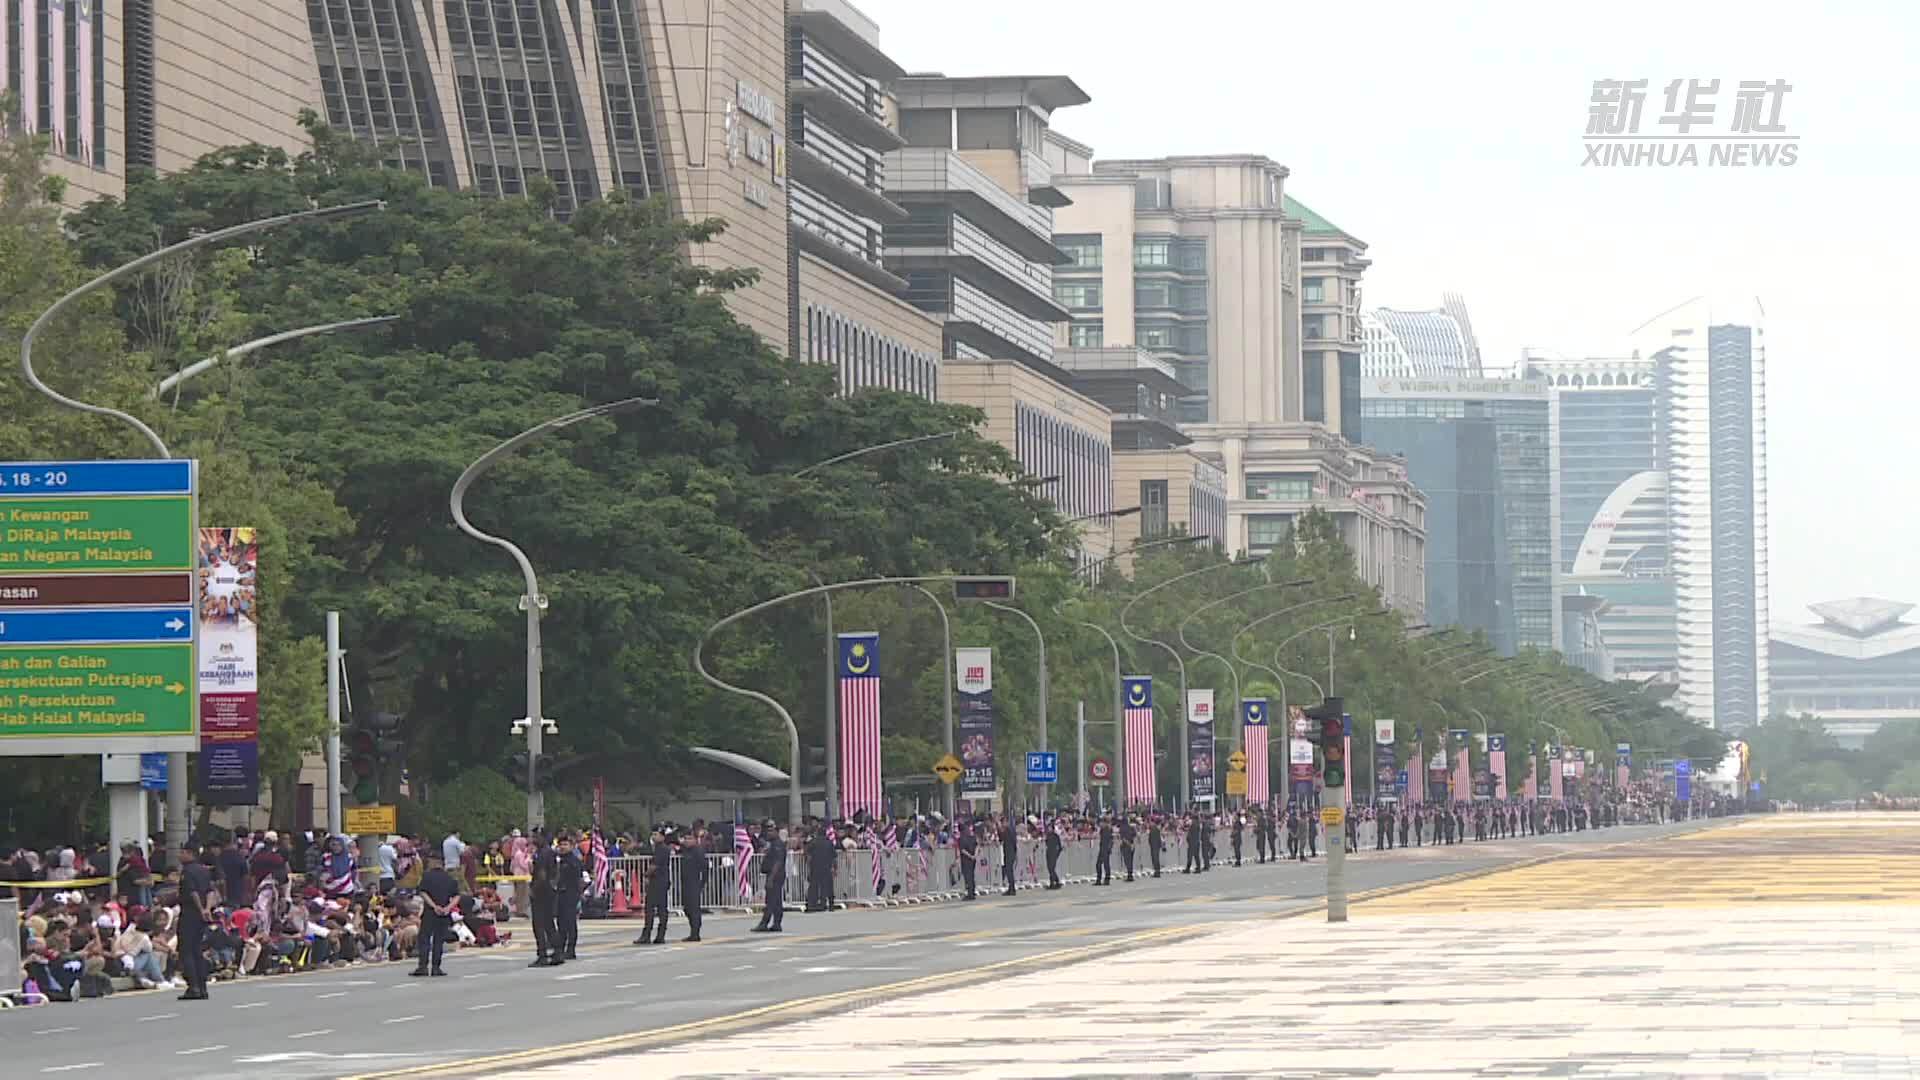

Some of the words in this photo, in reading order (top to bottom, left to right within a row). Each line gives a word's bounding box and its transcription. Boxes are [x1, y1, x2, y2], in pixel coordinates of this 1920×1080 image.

[13, 472, 31, 486] 18
[45, 471, 67, 485] 20
[11, 509, 90, 523] Kewangan
[8, 528, 60, 544] DiRaja
[64, 528, 133, 542] Malaysia
[24, 549, 80, 563] Negara
[86, 547, 153, 562] Malaysia
[25, 656, 52, 669] dan
[58, 655, 107, 669] Galian
[88, 673, 164, 688] Putrajaya
[19, 694, 116, 707] Persekutuan
[33, 711, 73, 724] Halal
[78, 710, 145, 725] Malaysia
